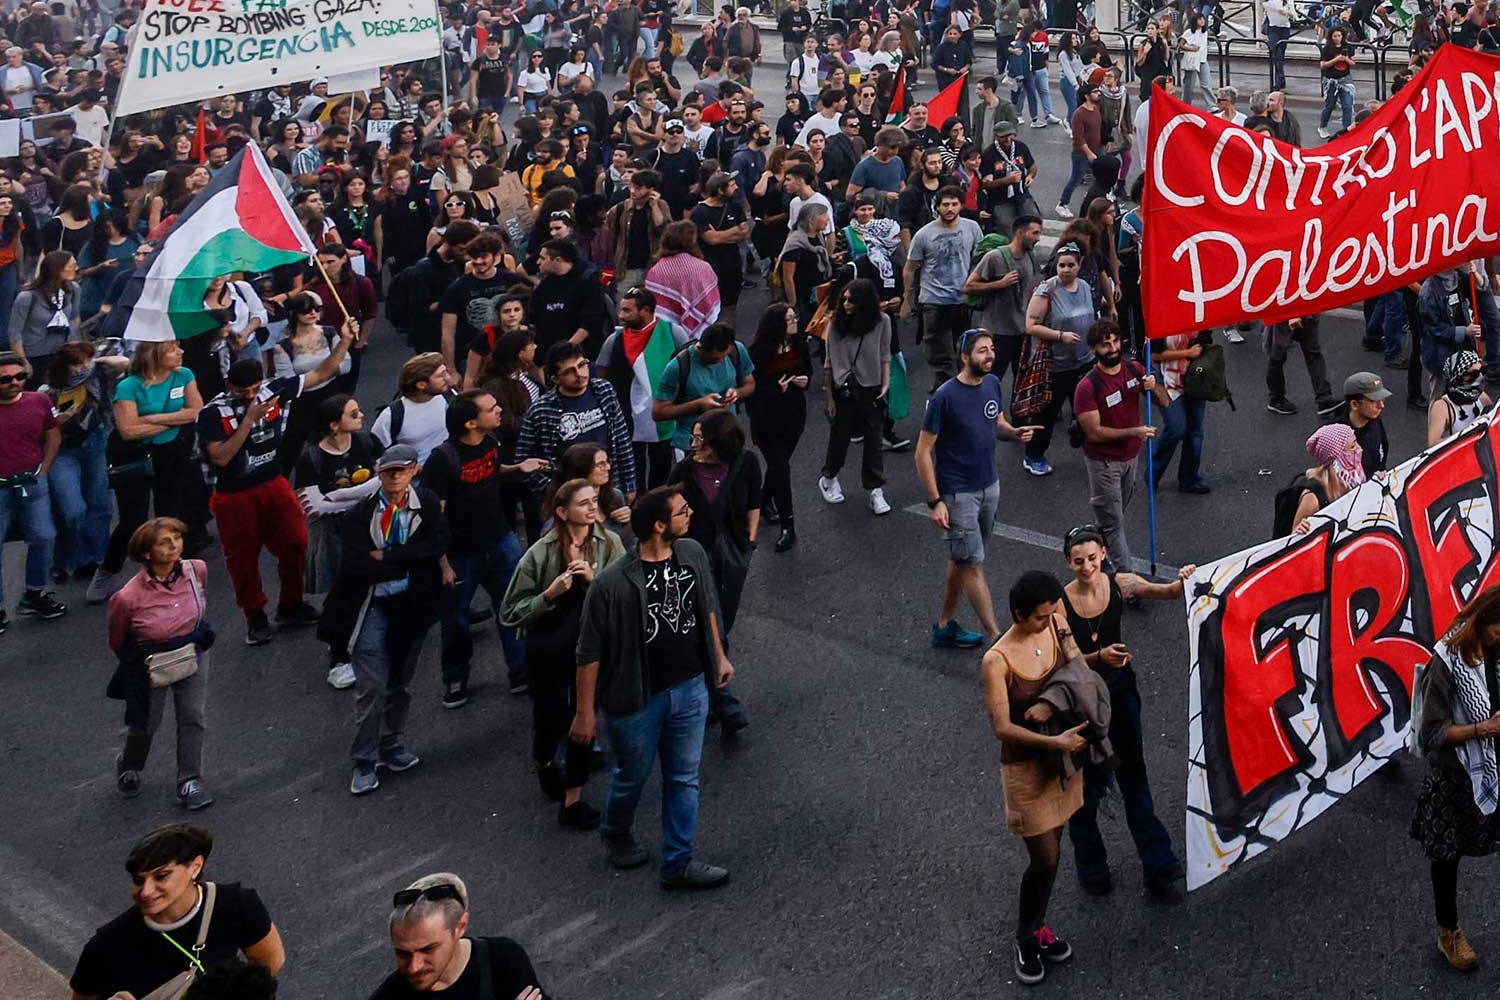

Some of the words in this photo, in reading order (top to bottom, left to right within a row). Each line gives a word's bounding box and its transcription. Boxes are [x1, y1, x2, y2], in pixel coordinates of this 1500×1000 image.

[138, 20, 356, 80] INSURGENCIA
[362, 18, 408, 37] DESDE
[145, 10, 210, 42] STOP
[217, 8, 306, 36] BOMBING
[1153, 113, 1398, 211] CONTRO
[1172, 187, 1500, 323] Palestina
